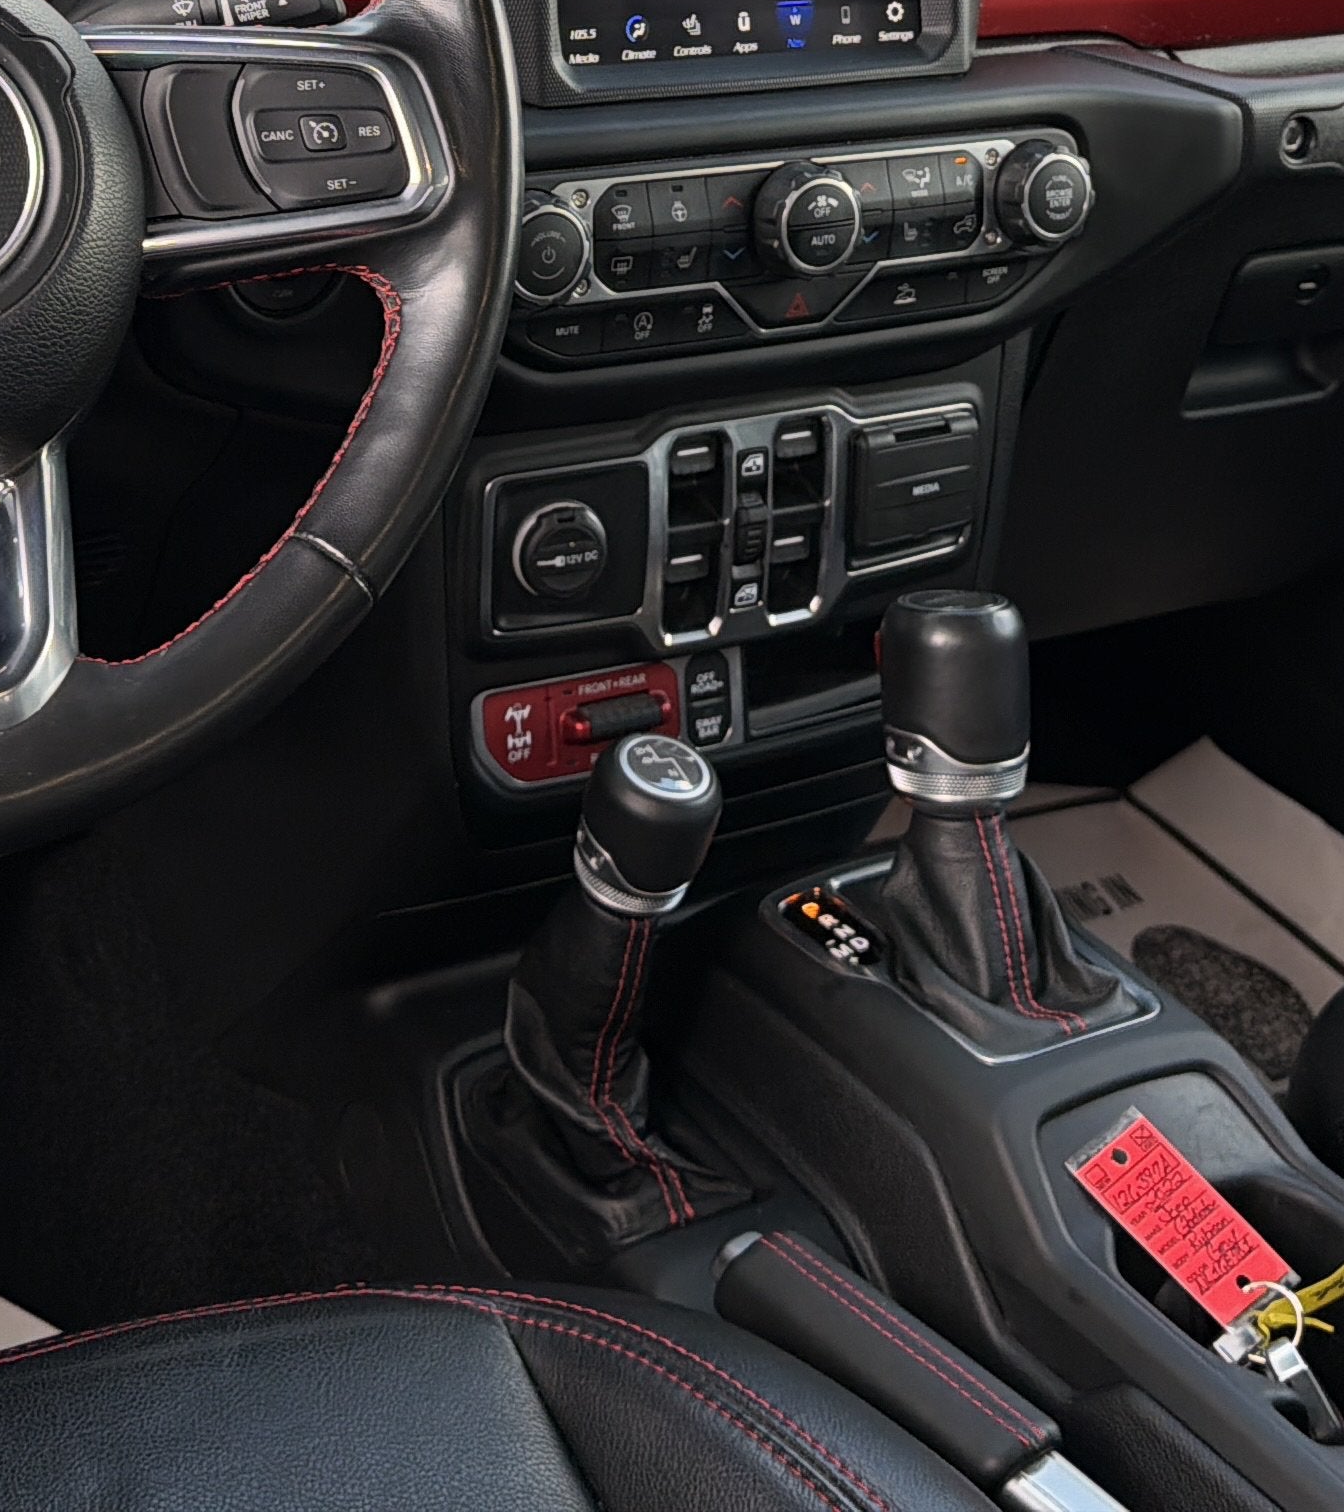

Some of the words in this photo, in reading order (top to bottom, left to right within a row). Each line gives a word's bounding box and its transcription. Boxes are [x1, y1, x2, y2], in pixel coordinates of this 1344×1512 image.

[234, 0, 267, 15] FRONT
[238, 9, 270, 23] WIPER
[789, 14, 802, 26] W
[569, 28, 597, 41] 105.5
[832, 33, 862, 46] Phone
[878, 28, 914, 43] Settings
[673, 43, 712, 57] Controls
[732, 41, 758, 55] Apps
[568, 52, 599, 65] Media
[621, 49, 657, 62] Climate
[261, 129, 294, 141] CANC
[358, 125, 381, 137] RES
[956, 174, 974, 186] A/C
[1049, 197, 1071, 209] ENTER
[813, 207, 831, 218] OFF
[612, 222, 636, 231] FRONT
[811, 234, 836, 246] AUTO
[556, 325, 579, 336] MUTE
[697, 323, 713, 334] OFF
[634, 331, 651, 341] OFF
[912, 481, 941, 496] MEDIA
[565, 551, 583, 565] 12V
[585, 548, 599, 562] DC
[697, 724, 720, 738] BAR
[508, 748, 532, 763] OFF
